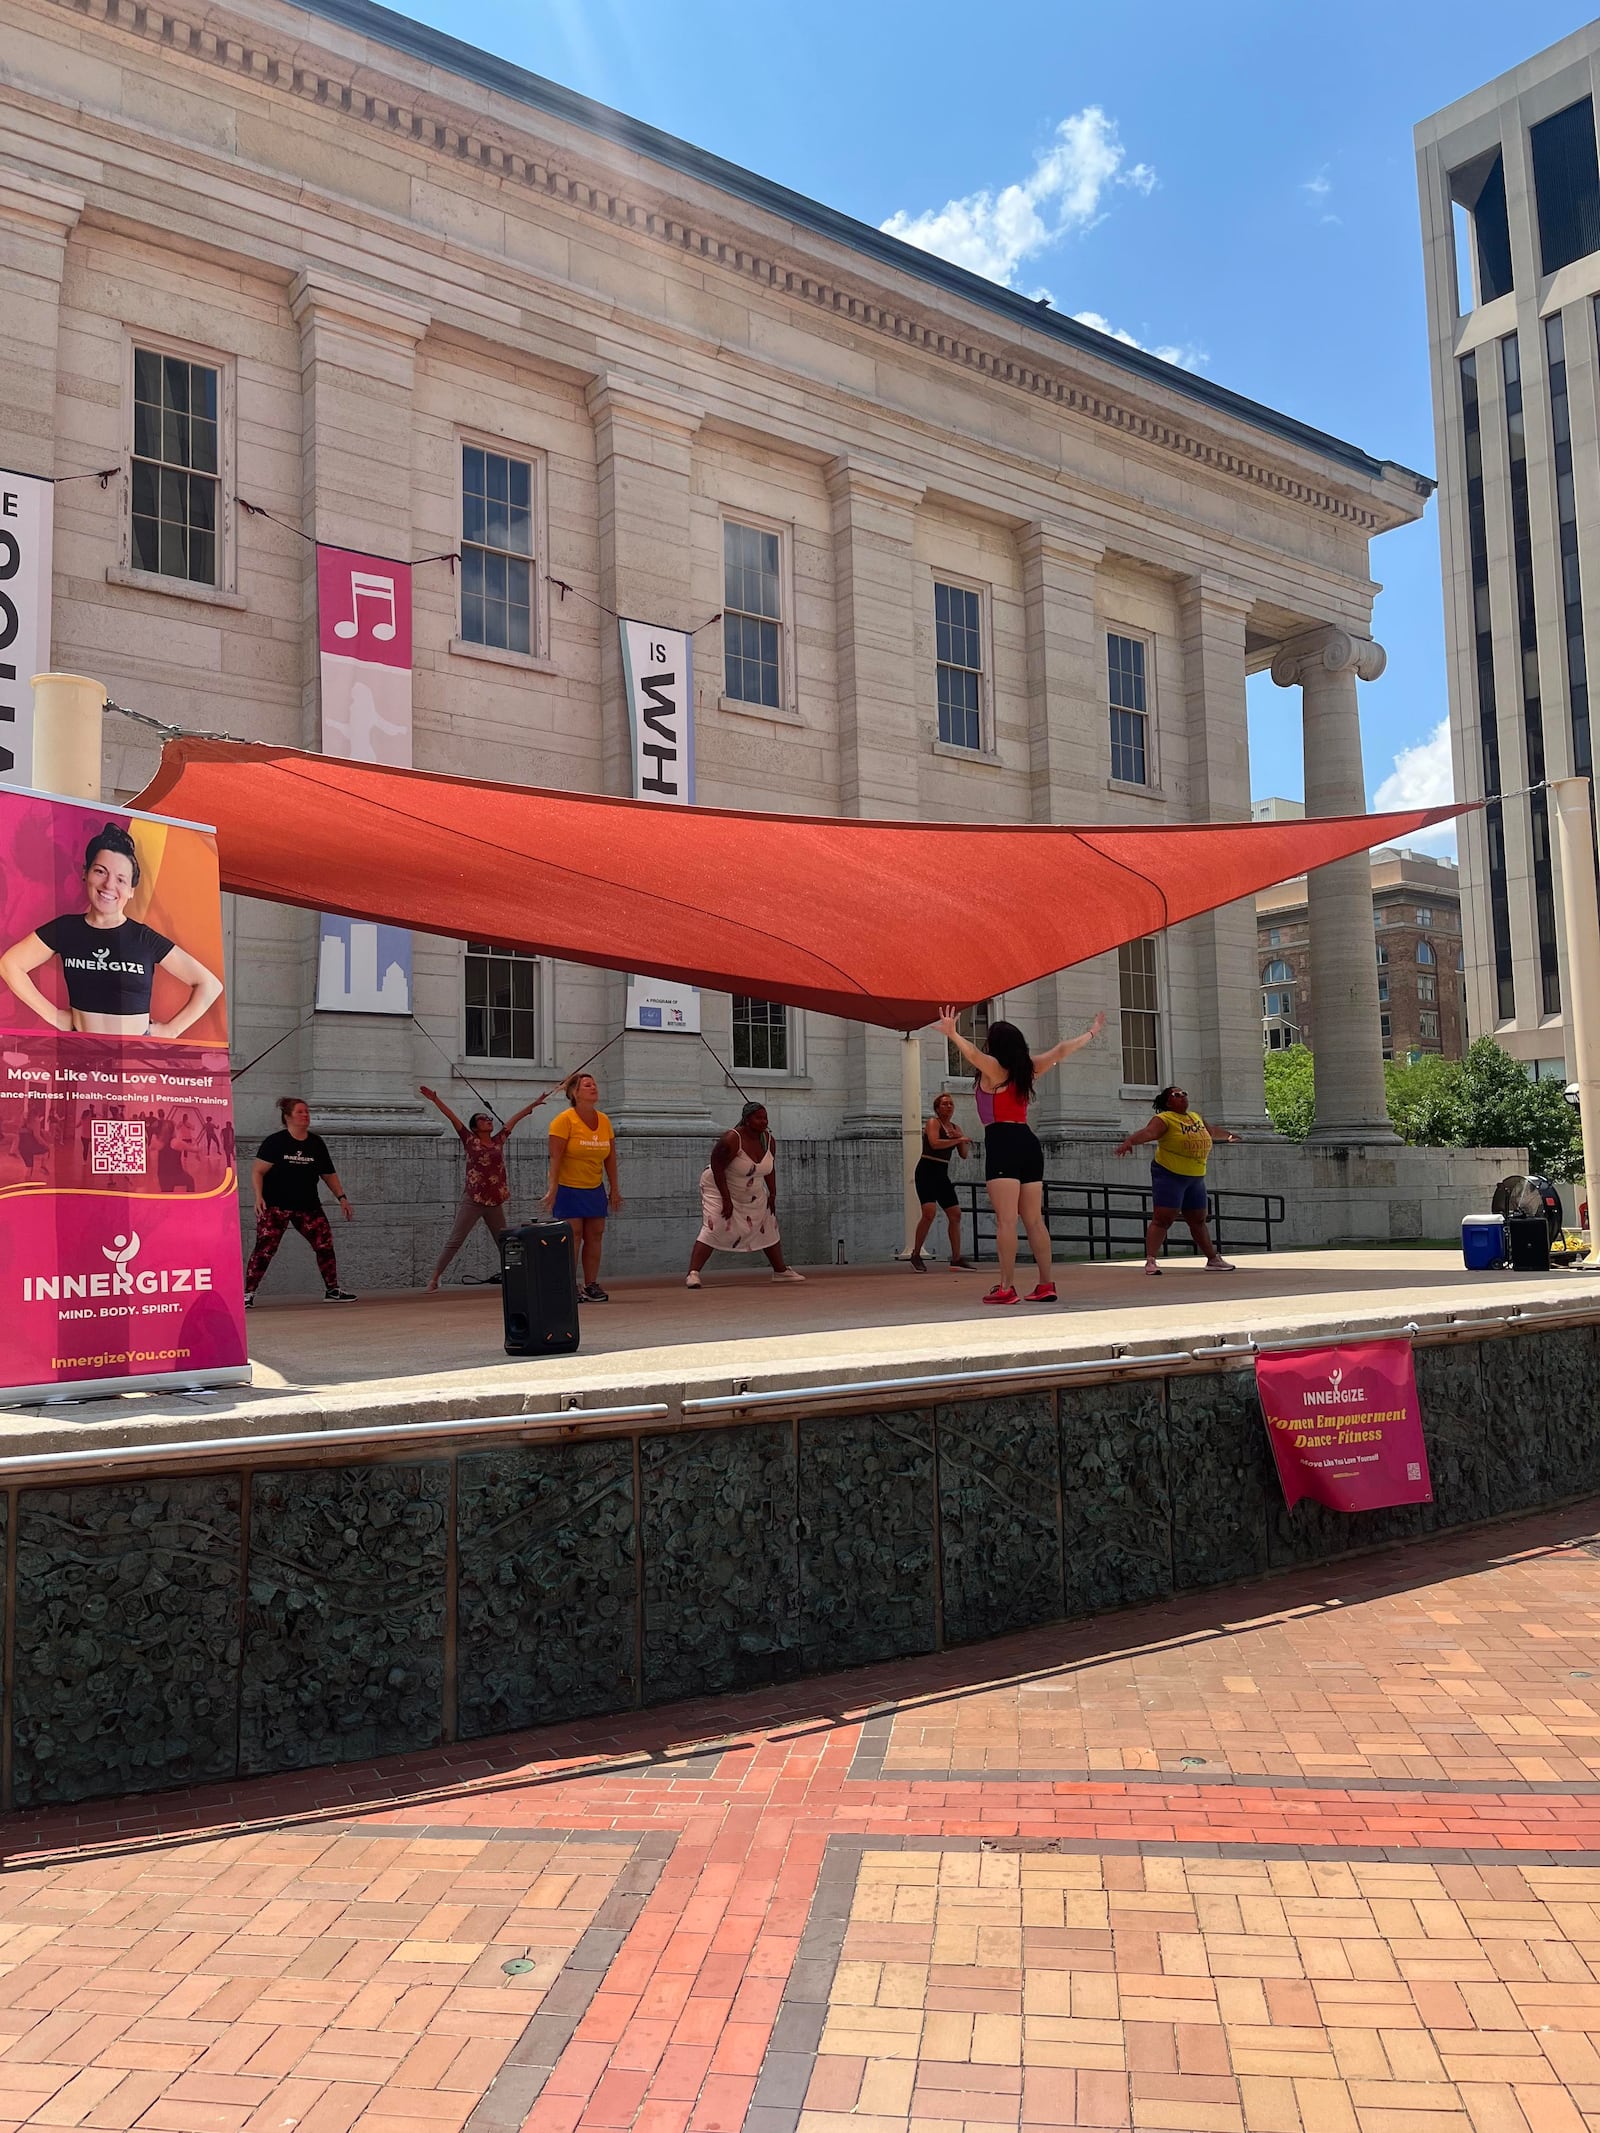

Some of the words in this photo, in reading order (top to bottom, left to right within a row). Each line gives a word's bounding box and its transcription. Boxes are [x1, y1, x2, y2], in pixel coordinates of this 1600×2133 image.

[650, 642, 666, 663] IS
[64, 958, 145, 974] INNERGIZE
[7, 1068, 51, 1081] Move
[55, 1069, 88, 1081] Like
[91, 1071, 118, 1083] You
[122, 1073, 157, 1084] Love
[160, 1074, 213, 1087] Yourself
[72, 1091, 149, 1103] Health-Coaching
[156, 1094, 228, 1106] Personal-Training
[23, 1268, 213, 1301] INNERGIZE
[58, 1310, 97, 1321] MIND.
[100, 1306, 139, 1318] BODY.
[142, 1303, 183, 1315] SPIRIT.
[51, 1347, 191, 1369] InnergizeYou.com
[1303, 1388, 1365, 1406] INNERGIZE
[1317, 1407, 1407, 1431] Empowerment
[1293, 1429, 1382, 1448] Dance-Fitness
